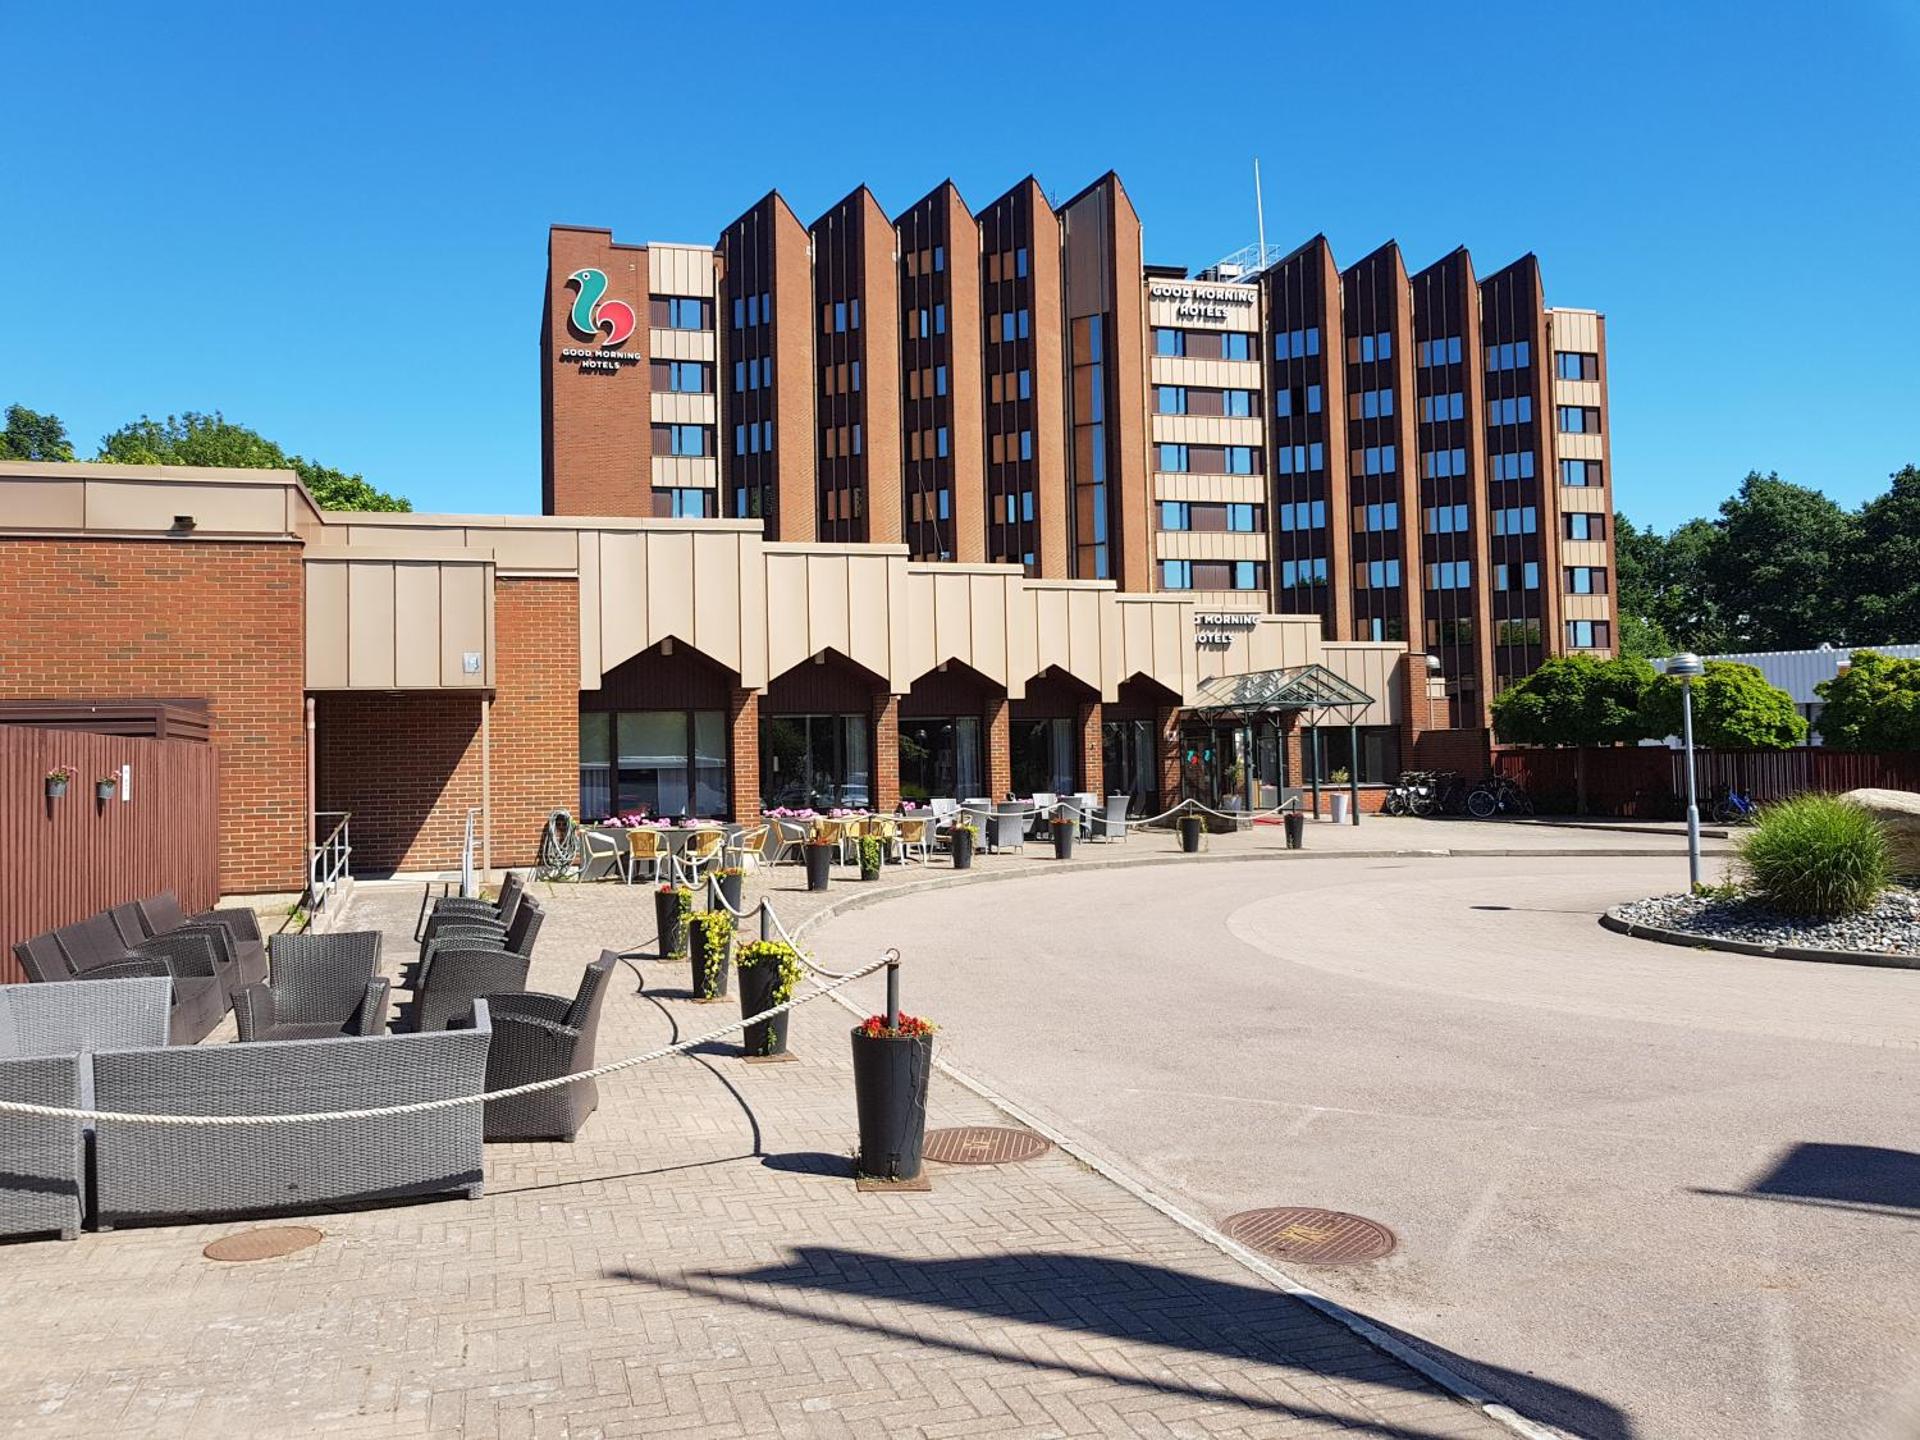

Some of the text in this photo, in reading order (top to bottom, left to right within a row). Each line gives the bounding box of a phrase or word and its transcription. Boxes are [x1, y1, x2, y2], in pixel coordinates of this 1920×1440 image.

[1152, 286, 1257, 302] GOOD MORNING
[1179, 304, 1230, 317] HOTELS
[562, 348, 641, 360] GOOD MORNING
[582, 360, 621, 369] HOTELS
[1204, 614, 1261, 624] MORNING
